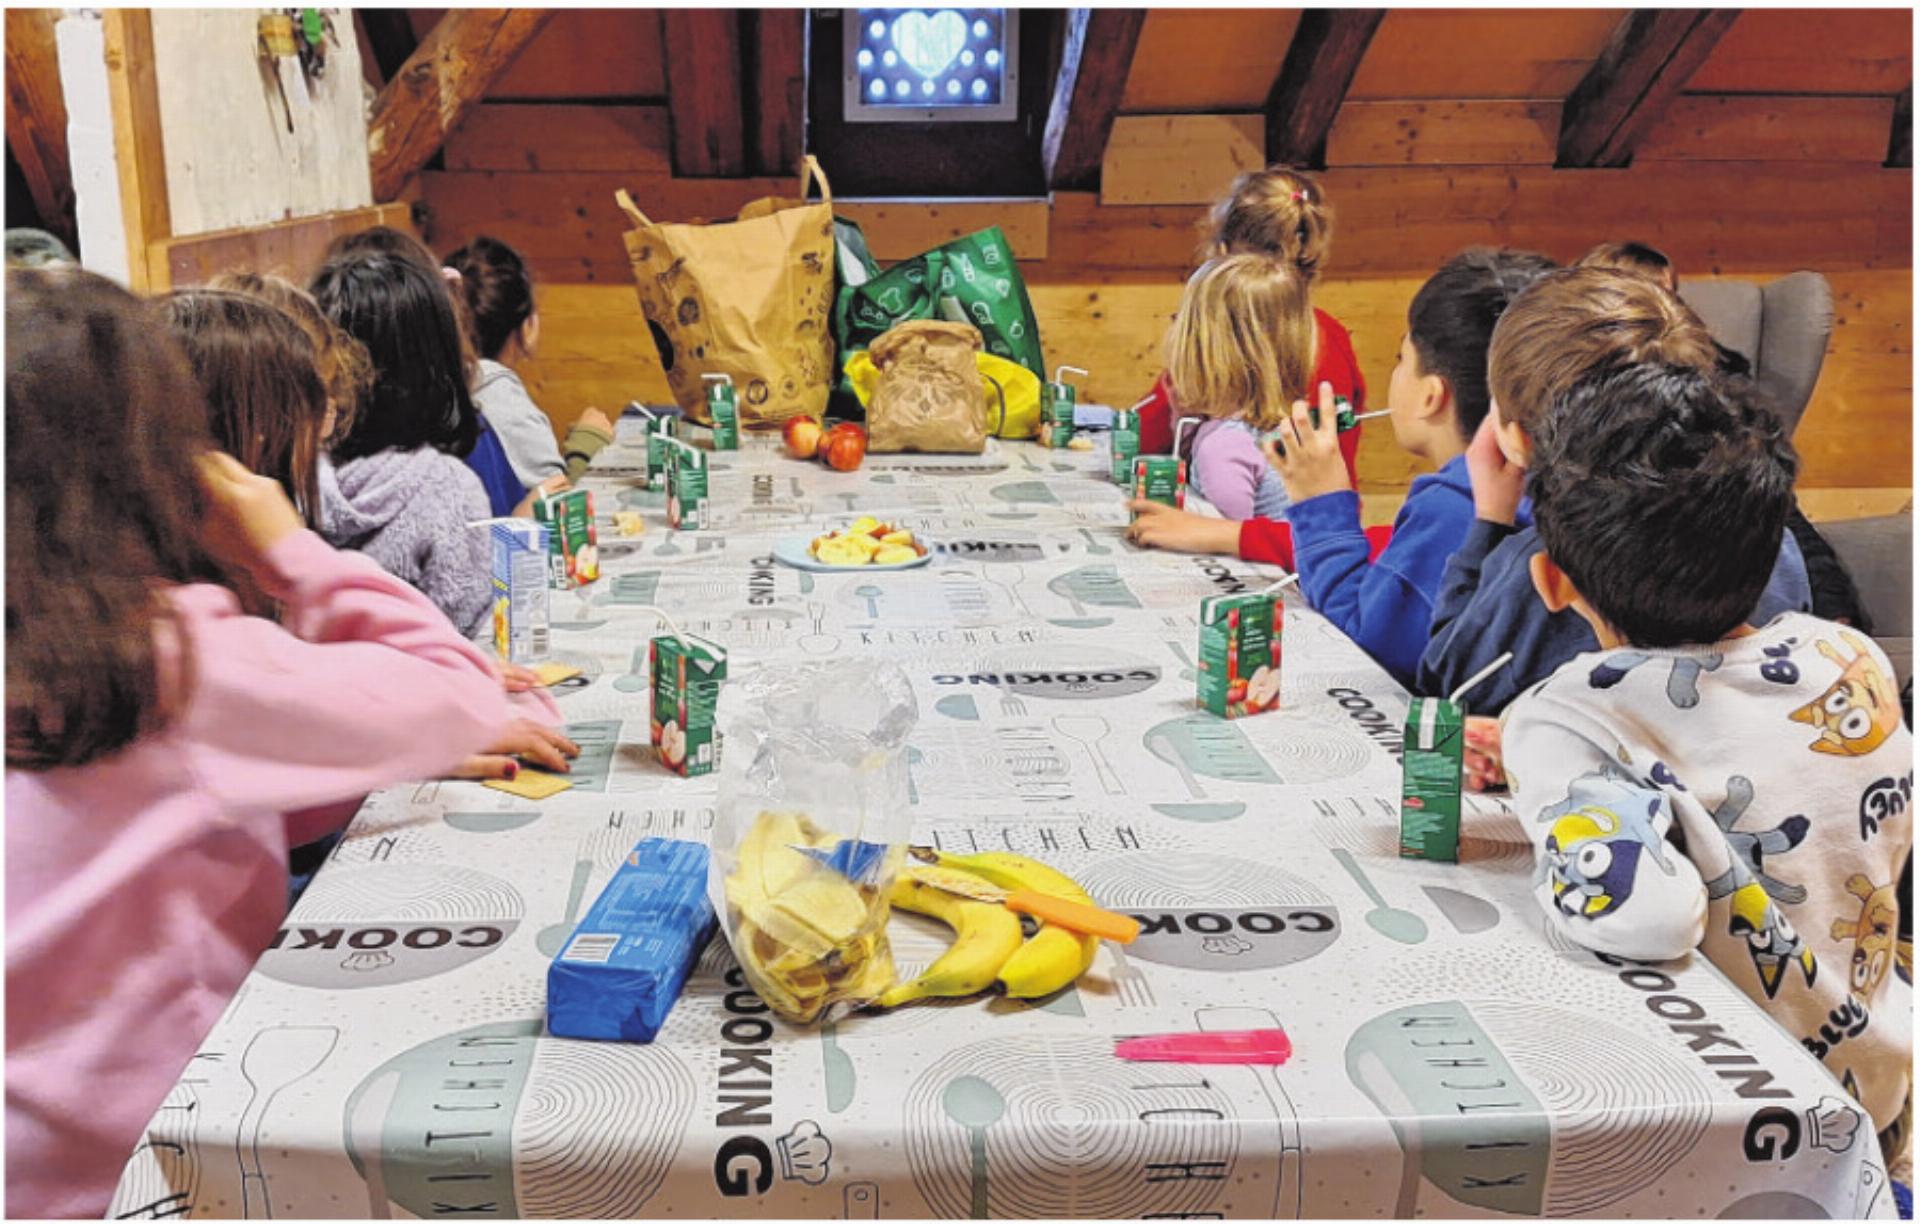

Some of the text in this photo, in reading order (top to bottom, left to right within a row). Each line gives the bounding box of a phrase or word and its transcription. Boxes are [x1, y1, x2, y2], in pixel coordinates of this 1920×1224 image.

[931, 670, 1157, 686] COOKING
[1326, 687, 1404, 766] COOKIN
[1860, 768, 1913, 842] LUEY
[932, 825, 1142, 851] ITCHEN
[1129, 911, 1336, 935] COOK
[267, 926, 503, 950] COOKI
[1594, 951, 1801, 1162] OOKING
